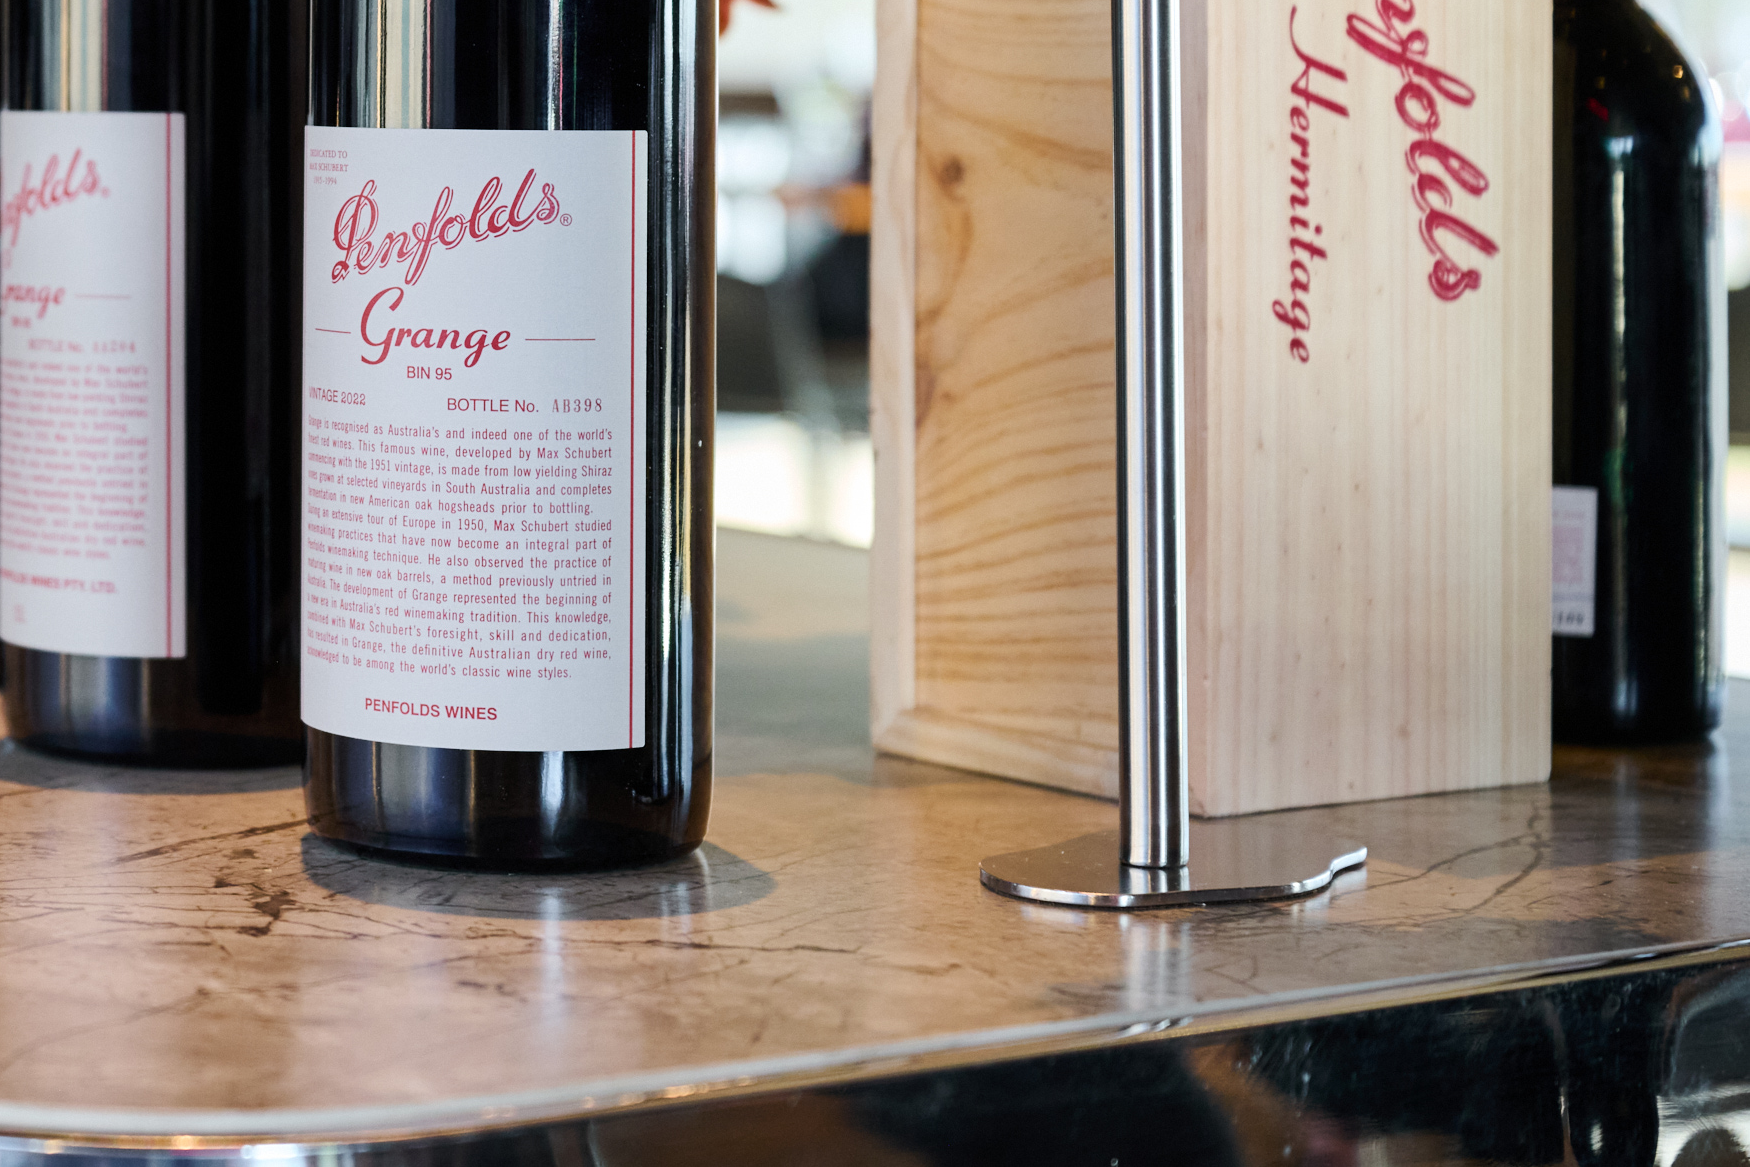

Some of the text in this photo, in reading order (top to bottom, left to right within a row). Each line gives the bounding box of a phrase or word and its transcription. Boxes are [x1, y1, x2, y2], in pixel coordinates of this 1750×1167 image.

[338, 150, 348, 159] TO
[0, 148, 100, 247] folds
[1271, 5, 1349, 365] Hermitage
[331, 168, 560, 286] Penfolds
[360, 286, 512, 368] Grange
[406, 365, 452, 381] BIN 95
[308, 386, 367, 407] VINTAGE 2022
[446, 397, 603, 414] BOTTLE No. AB398
[331, 421, 370, 434] recognised
[373, 425, 384, 435] as
[387, 424, 440, 438] Australia's
[445, 428, 466, 440] and
[471, 428, 508, 441] indeed
[513, 431, 533, 441] one
[538, 428, 550, 441] of
[554, 429, 572, 441] the
[576, 428, 613, 441] world's
[332, 440, 355, 450] wines.
[357, 439, 376, 453] This
[379, 441, 416, 455] famous
[420, 444, 449, 458] wine,
[454, 445, 512, 461] developed
[518, 447, 532, 461] by
[536, 447, 560, 459] Max
[564, 446, 613, 459] Schubert
[338, 456, 353, 467] with
[354, 457, 368, 470] the
[370, 458, 391, 472] 1951
[394, 461, 434, 476] vintage,
[437, 463, 448, 475] is
[451, 464, 481, 476] made
[483, 464, 509, 477] from
[513, 465, 532, 477] low
[534, 465, 578, 480] yielding
[581, 465, 613, 478] Shiraz
[336, 474, 345, 485] at
[346, 474, 379, 489] selected
[381, 478, 427, 493] vineyards
[431, 481, 442, 493] in
[445, 481, 476, 495] South
[480, 483, 531, 495] Australia
[535, 484, 556, 496] and
[560, 484, 613, 498] completes
[339, 491, 347, 502] in
[349, 495, 365, 505] new
[368, 494, 410, 509] American
[414, 498, 433, 510] oak
[437, 499, 496, 514] hogsheads
[501, 501, 528, 516] prior
[532, 502, 544, 514] to
[549, 502, 594, 516] bottling.
[331, 509, 364, 523] extensive
[366, 513, 385, 525] tour
[388, 515, 398, 527] of
[402, 515, 436, 531] Europe
[441, 518, 452, 530] in
[458, 518, 488, 533] 1950,
[493, 519, 516, 532] Max
[520, 519, 569, 532] Schubert
[574, 519, 612, 532] studied
[337, 529, 374, 542] practices
[377, 532, 397, 544] that
[401, 534, 426, 546] have
[430, 538, 452, 548] now
[457, 536, 500, 550] become
[505, 540, 519, 550] an
[525, 538, 570, 553] integral
[575, 538, 598, 553] part
[601, 536, 613, 550] of
[326, 545, 369, 562] winemaking
[372, 549, 422, 566] technique.
[427, 553, 441, 566] He
[445, 554, 469, 567] also
[474, 556, 524, 569] observed
[529, 556, 548, 568] the
[553, 557, 598, 571] practice
[601, 555, 612, 568] of
[345, 563, 353, 575] in
[356, 568, 373, 578] new
[375, 568, 393, 580] oak
[396, 569, 435, 585] barrels,
[440, 574, 447, 584] a
[452, 573, 493, 586] method
[498, 575, 555, 589] previously
[559, 574, 597, 587] untried
[602, 574, 612, 586] in
[329, 578, 341, 592] The
[342, 581, 394, 598] development
[397, 587, 408, 599] of
[411, 588, 448, 605] Grange
[453, 593, 517, 605] represented
[521, 593, 540, 605] the
[545, 593, 598, 608] beginning
[601, 592, 612, 604] of
[330, 600, 338, 608] in
[339, 598, 381, 615] Australia's
[384, 605, 400, 617] red
[403, 607, 465, 624] winemaking
[469, 610, 521, 623] tradition.
[526, 611, 550, 623] This
[554, 611, 612, 625] knowledge,
[331, 616, 347, 628] with
[349, 618, 366, 631] Max
[368, 620, 422, 637] Schubert's
[426, 625, 483, 642] foresight,
[488, 629, 515, 641] skill
[520, 629, 543, 641] and
[547, 629, 612, 642] dedication,
[341, 635, 349, 647] in
[351, 636, 386, 654] Grange,
[390, 641, 407, 654] the
[411, 643, 464, 658] definitive
[468, 646, 531, 660] Australian
[536, 648, 555, 662] dry
[560, 648, 578, 660] red
[582, 648, 612, 660] wine,
[341, 653, 350, 665] to
[352, 655, 363, 667] be
[365, 659, 395, 673] among
[399, 660, 416, 673] the
[419, 663, 457, 676] world's
[461, 665, 501, 678] classic
[505, 666, 532, 678] wine
[537, 667, 572, 681] styles.
[365, 697, 498, 721] PENFOLDS WINES
